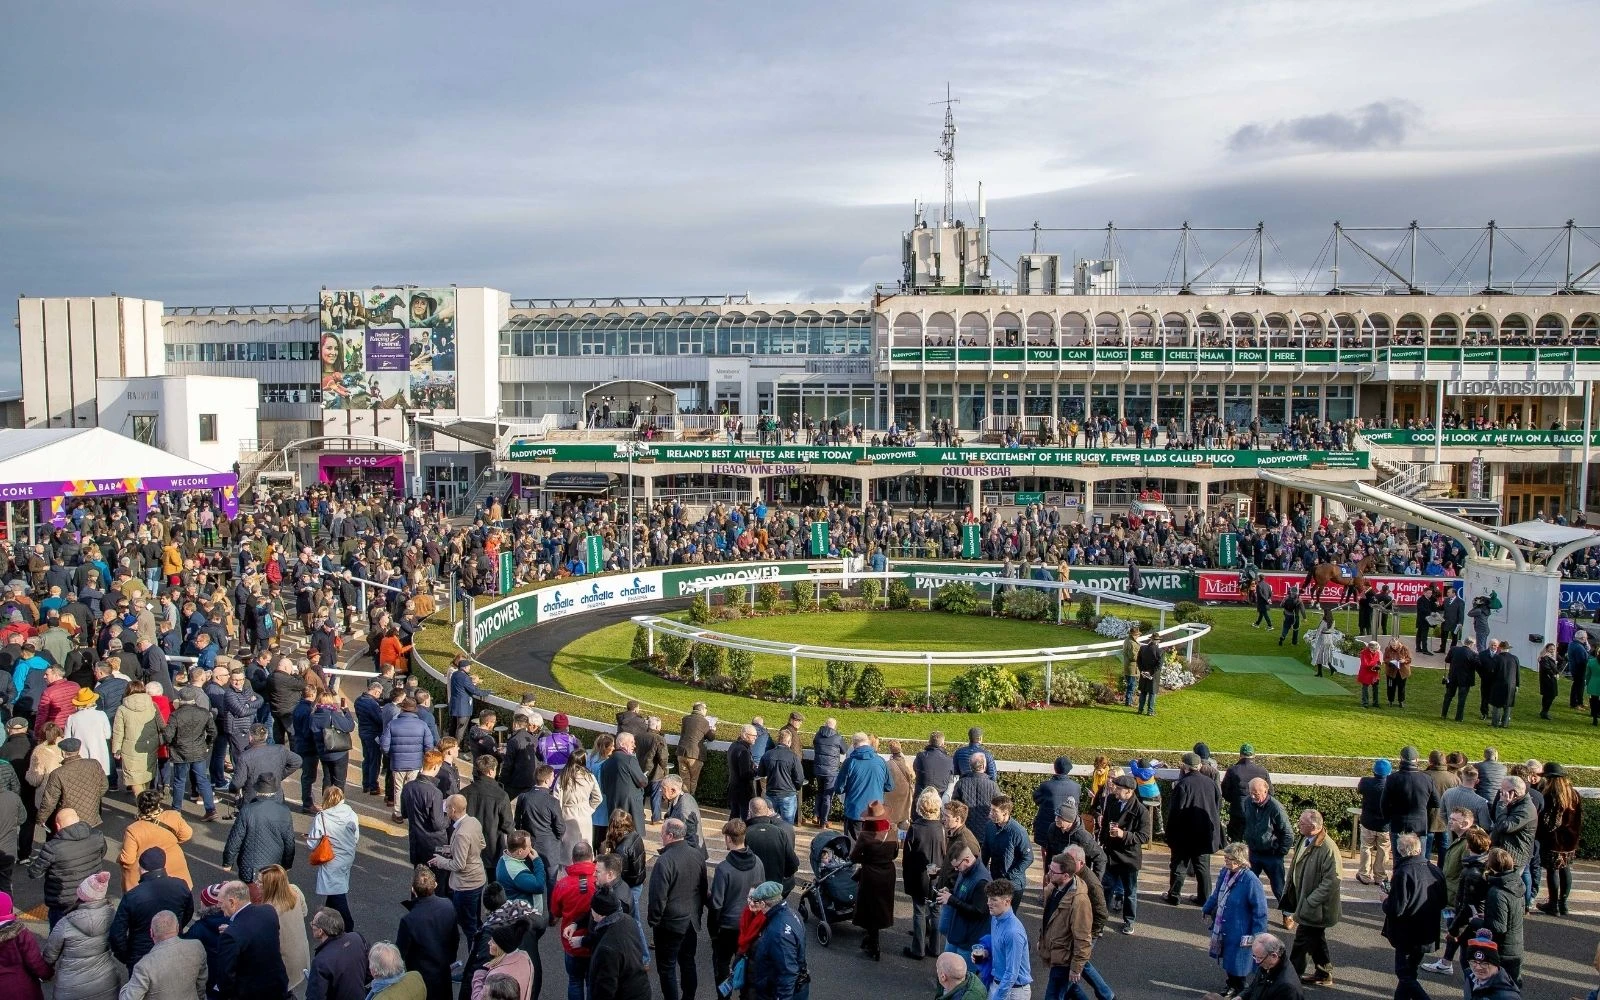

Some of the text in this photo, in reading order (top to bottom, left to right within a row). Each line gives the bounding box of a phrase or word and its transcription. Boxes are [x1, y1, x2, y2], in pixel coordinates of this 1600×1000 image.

[1034, 350, 1297, 360] YOU CAN ALMOST SEE CHELTENHAM FROM HERE.
[1453, 381, 1576, 395] LEOPARDSTOWN
[1451, 433, 1478, 442] LOOK
[1480, 433, 1492, 442] AT
[1495, 433, 1508, 442] ME
[1509, 434, 1524, 442] I'M
[1526, 434, 1541, 442] ON
[1543, 434, 1551, 442] A
[1553, 434, 1597, 442] BALCOY
[666, 449, 853, 460] IRELAND'S BEST ATHLETES ARE HERE TODAY
[941, 452, 1235, 463] ALL THE EXCITEMENT OF THE RUGBY, FEWER LADS CALLED HUGO
[711, 464, 796, 475] LEGACY WINE BAR
[942, 466, 1011, 476] COLOURS BAR
[98, 483, 116, 491] BAR
[170, 478, 209, 487] WELCOME
[620, 584, 656, 598] chanelle
[580, 590, 614, 604] chanelle
[543, 598, 574, 613] chanelle
